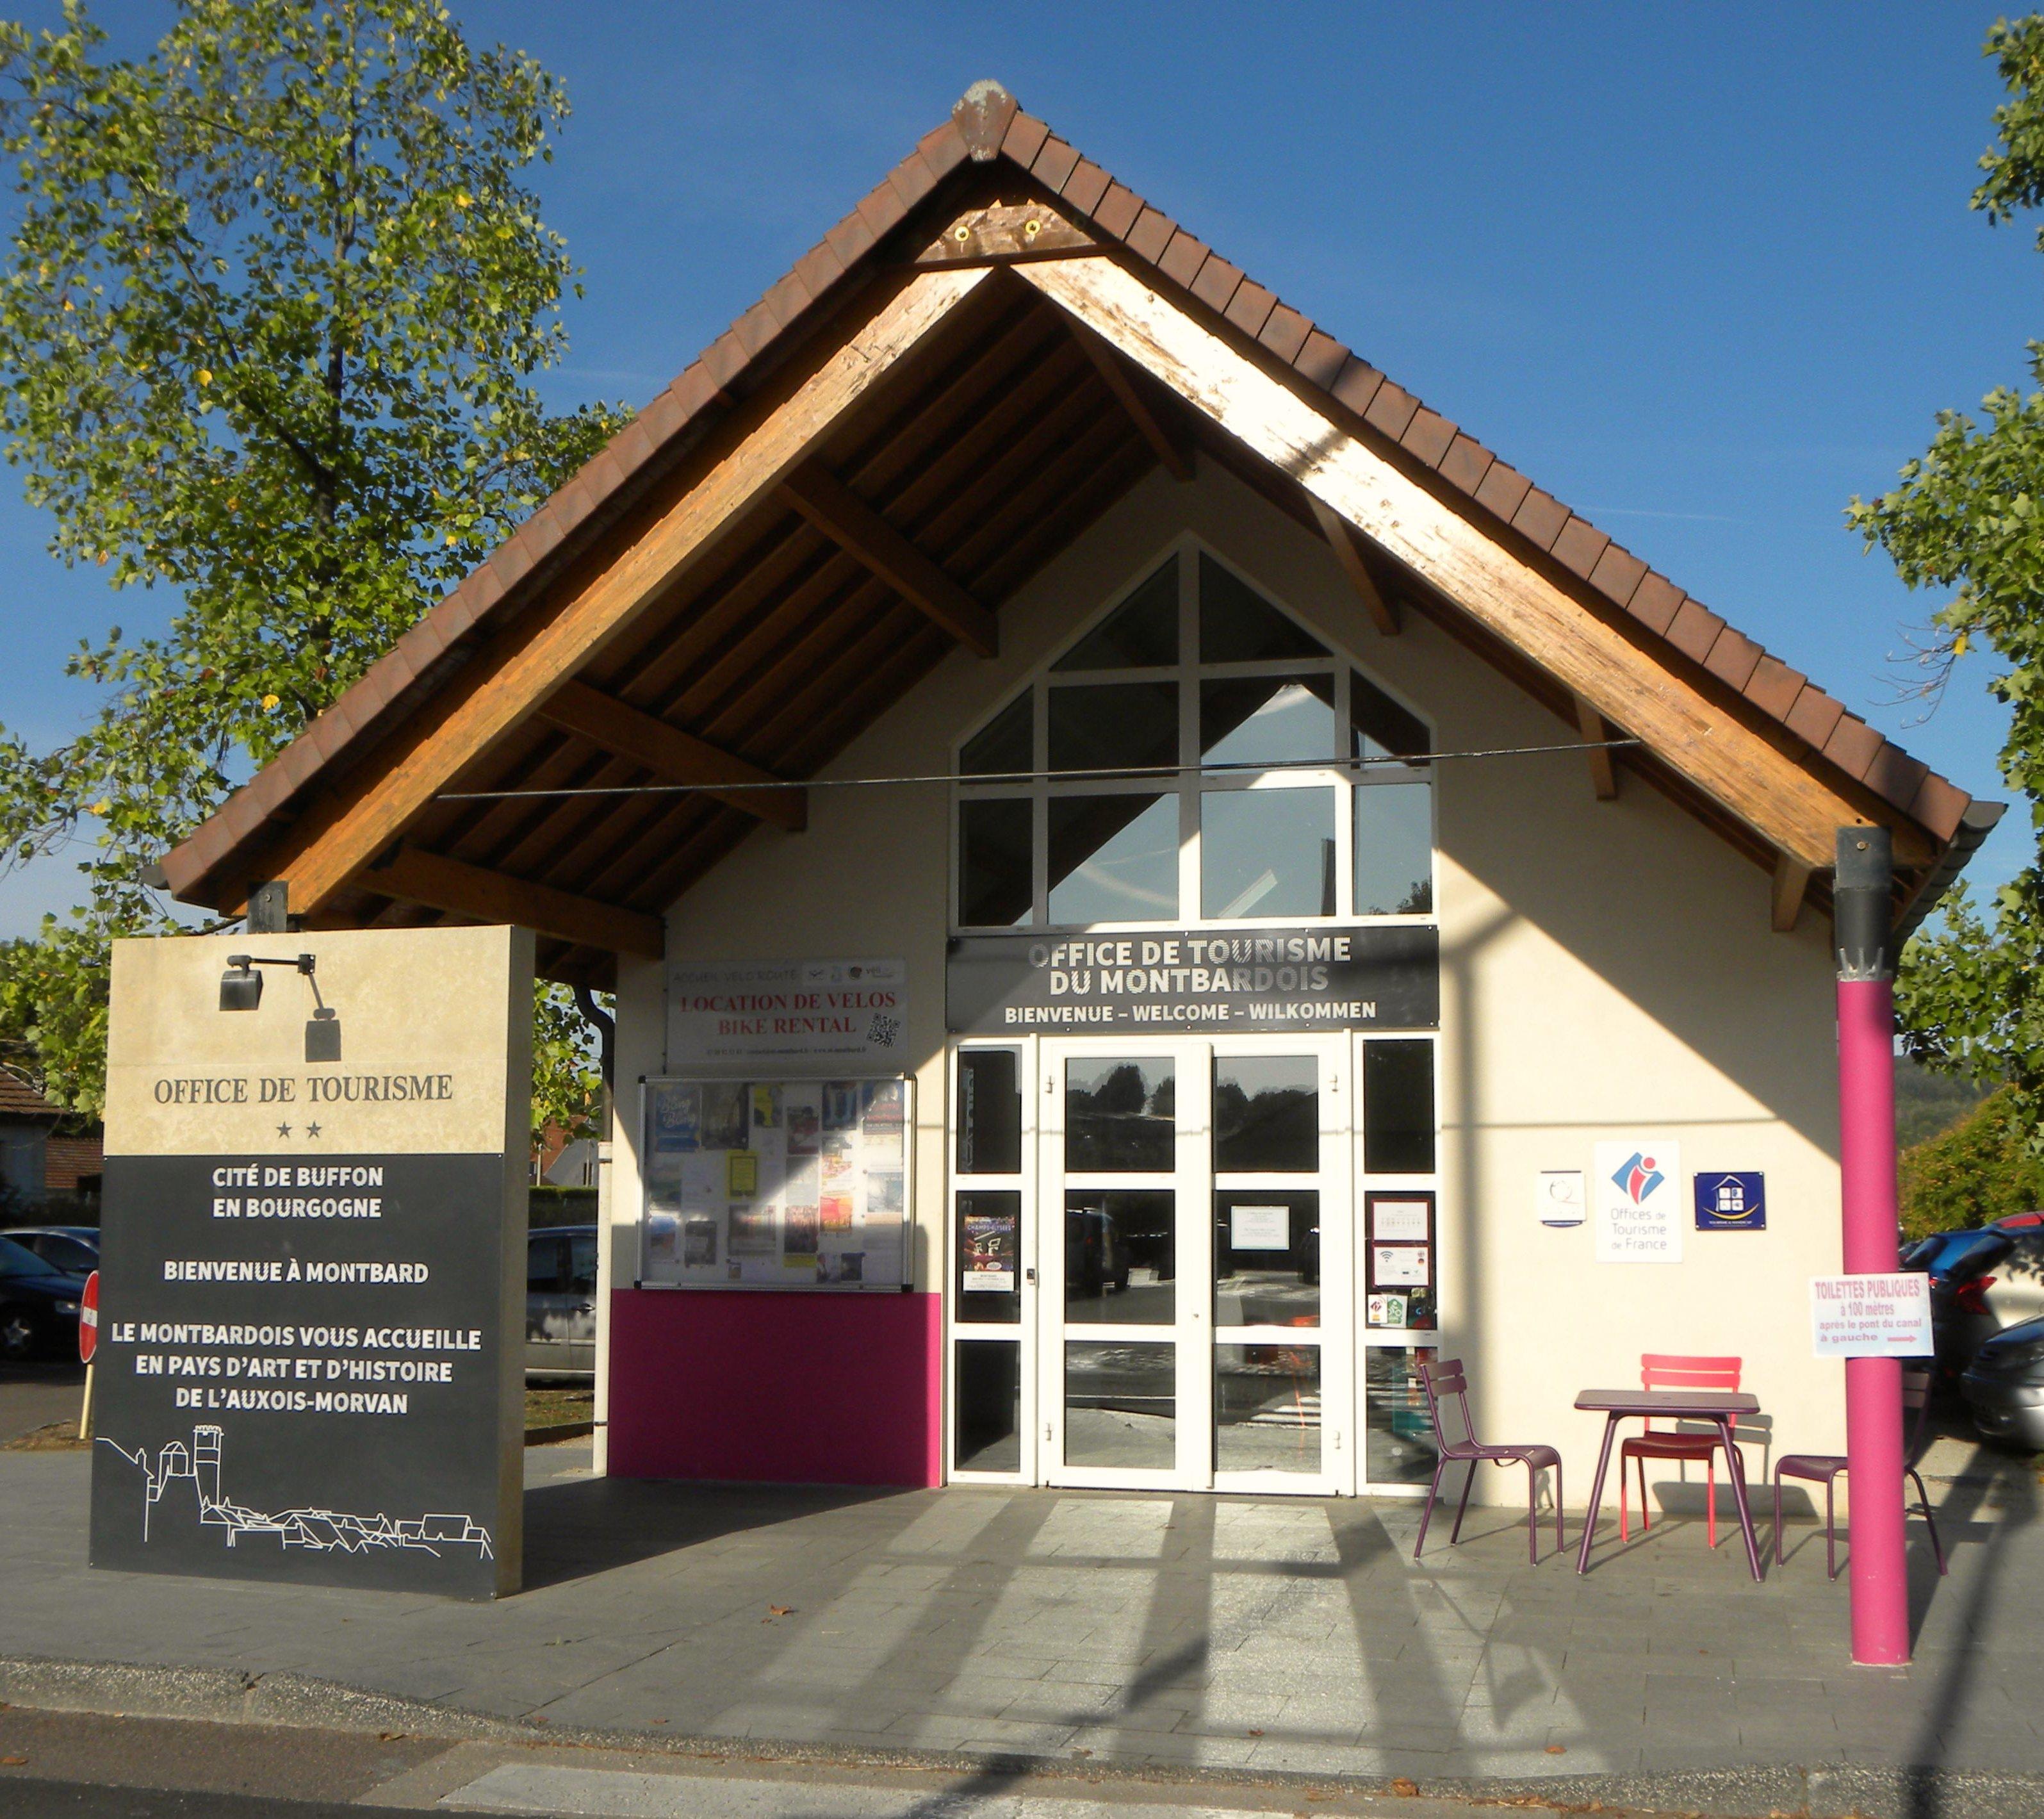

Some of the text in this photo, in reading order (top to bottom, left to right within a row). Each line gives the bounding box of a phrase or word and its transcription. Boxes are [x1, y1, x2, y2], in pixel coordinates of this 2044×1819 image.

[1029, 936, 1350, 968] OFFICE DE TOURISME
[1050, 965, 1329, 995] DU MONTBARDOIS
[680, 992, 895, 1012] LOCATION DE VELOS
[1004, 1006, 1113, 1024] BIENVENUE
[1132, 1003, 1229, 1022] WELCOME
[1248, 1001, 1377, 1020] WILKOMMEN
[719, 1016, 857, 1036] BIKE RENTAL
[154, 1074, 454, 1104] OFFICE DE TOURISME
[212, 1164, 384, 1187] CITÉ DE BUFFON
[213, 1198, 382, 1218] EN BOURGOGNE
[1610, 1208, 1652, 1220] Offices
[1612, 1222, 1667, 1235] Tourisme
[1626, 1237, 1667, 1250] France
[164, 1259, 429, 1283] BIENVENUE À MONTBARD
[1815, 1278, 1920, 1299] TOILETTES PUBLIQUES
[1849, 1301, 1863, 1315] 100
[1848, 1320, 1856, 1328] le
[1859, 1319, 1879, 1330] pont
[1882, 1319, 1893, 1328] du
[1897, 1317, 1922, 1328] canal
[111, 1323, 481, 1350] LE MONTBARDOIS VOUS ACCUEILLE
[1831, 1333, 1878, 1343] gauche
[136, 1356, 163, 1374] EN
[168, 1356, 221, 1376] PAYS
[295, 1359, 322, 1379] ET
[176, 1388, 202, 1407] DE
